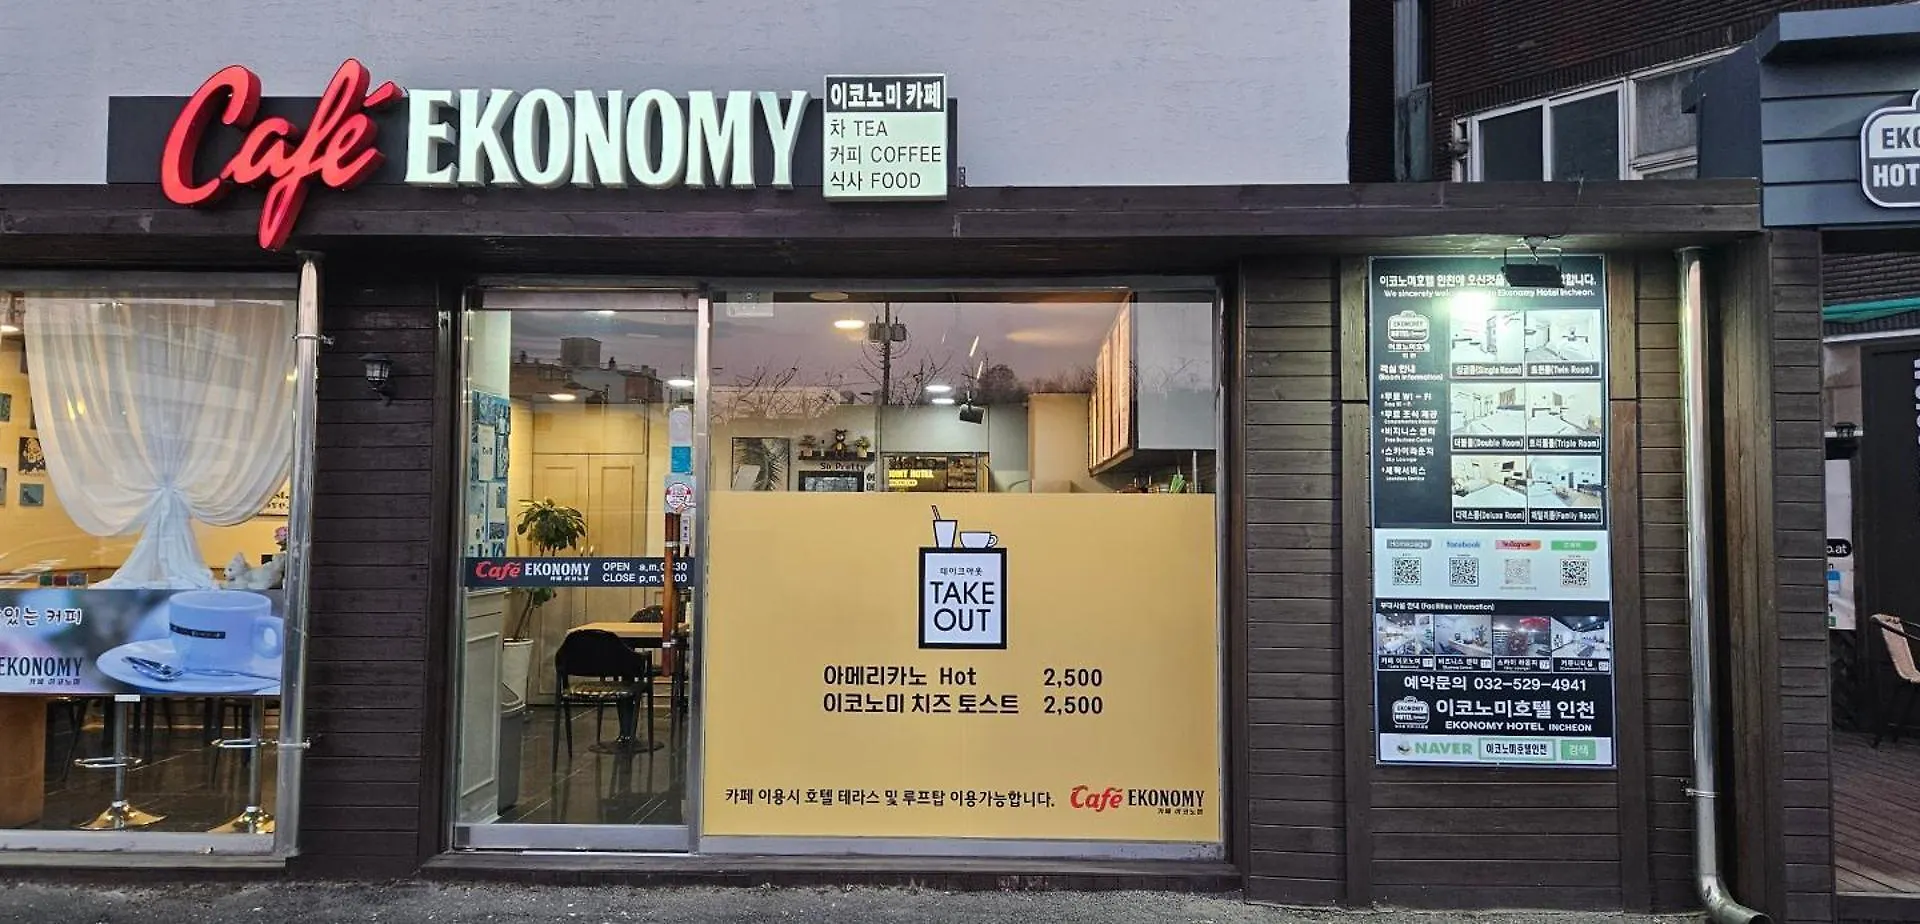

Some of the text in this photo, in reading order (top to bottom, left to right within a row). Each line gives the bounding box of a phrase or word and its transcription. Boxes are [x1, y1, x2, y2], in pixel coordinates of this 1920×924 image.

[830, 80, 941, 110] 이코노미 카페
[830, 119, 888, 138] 차 TEA
[161, 58, 810, 251] Café EKONOMY
[830, 145, 941, 165] 커피 COFFEE
[830, 171, 921, 191] 식사 FOOD
[1872, 163, 1920, 187] HOT
[474, 560, 591, 581] Café EKONOMY
[602, 562, 630, 572] OPEN
[602, 572, 636, 582] CLOSE
[929, 581, 995, 605] TAKE
[0, 606, 82, 627] 있는 커피
[933, 607, 992, 632] OUT
[823, 664, 1103, 689] 아메리카노 Hot 2,500
[1403, 675, 1587, 692] 예약문의 032-529-4941
[823, 692, 1103, 716] 이코노미 치즈 토스트 2,500
[1435, 698, 1595, 720] 이코노미호텔 인천
[1445, 721, 1592, 732] EKONOMY HOTEL INCHEON
[1415, 742, 1473, 755] NAVER
[1486, 743, 1548, 756] 이코노미호텔인천
[1568, 743, 1590, 758] 검색
[725, 788, 1056, 808] 카페 이용시 호텔 테라스 및 루프탑 이용가능합니다.
[1070, 784, 1205, 813] Café EKONOMY
